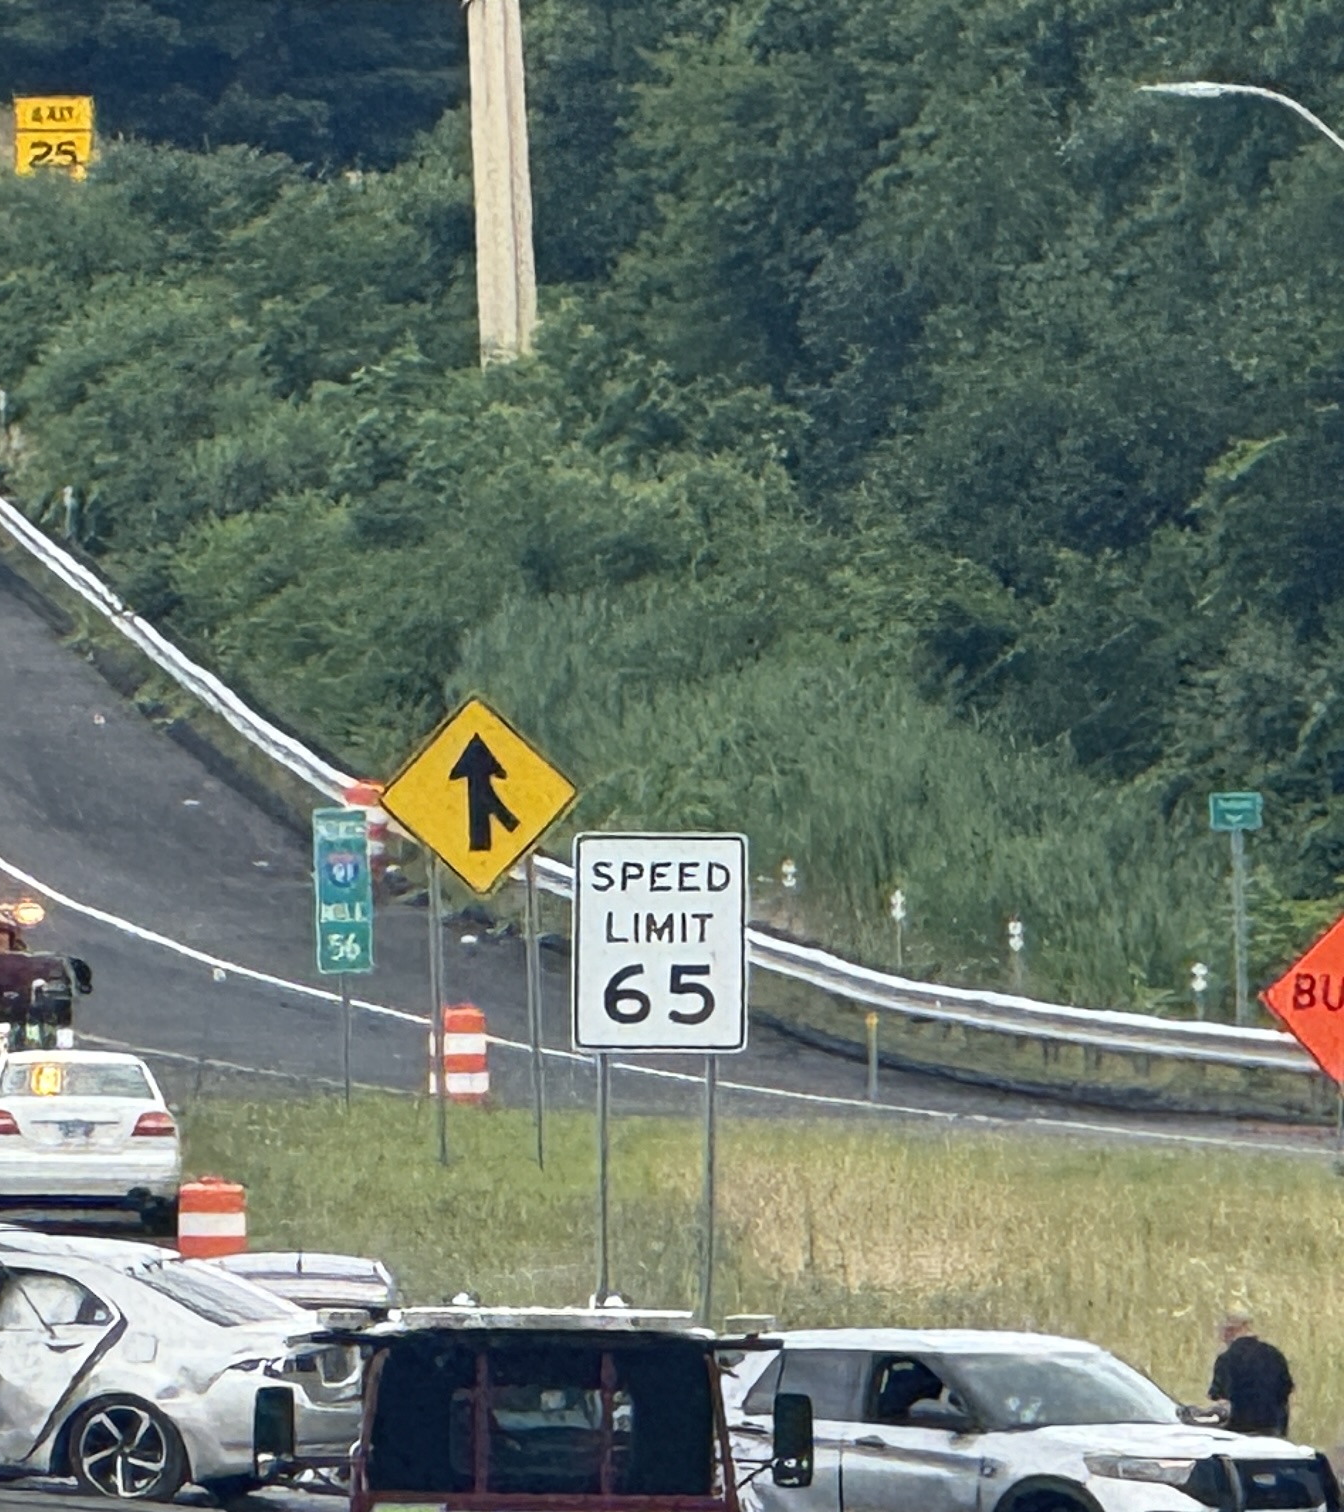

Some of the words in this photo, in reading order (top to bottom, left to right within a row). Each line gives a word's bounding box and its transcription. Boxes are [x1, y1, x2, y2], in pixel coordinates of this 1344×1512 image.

[29, 140, 77, 168] 25
[591, 861, 731, 892] SPEED
[605, 911, 713, 943] LIMIT
[328, 932, 361, 961] 56
[603, 963, 716, 1025] 65
